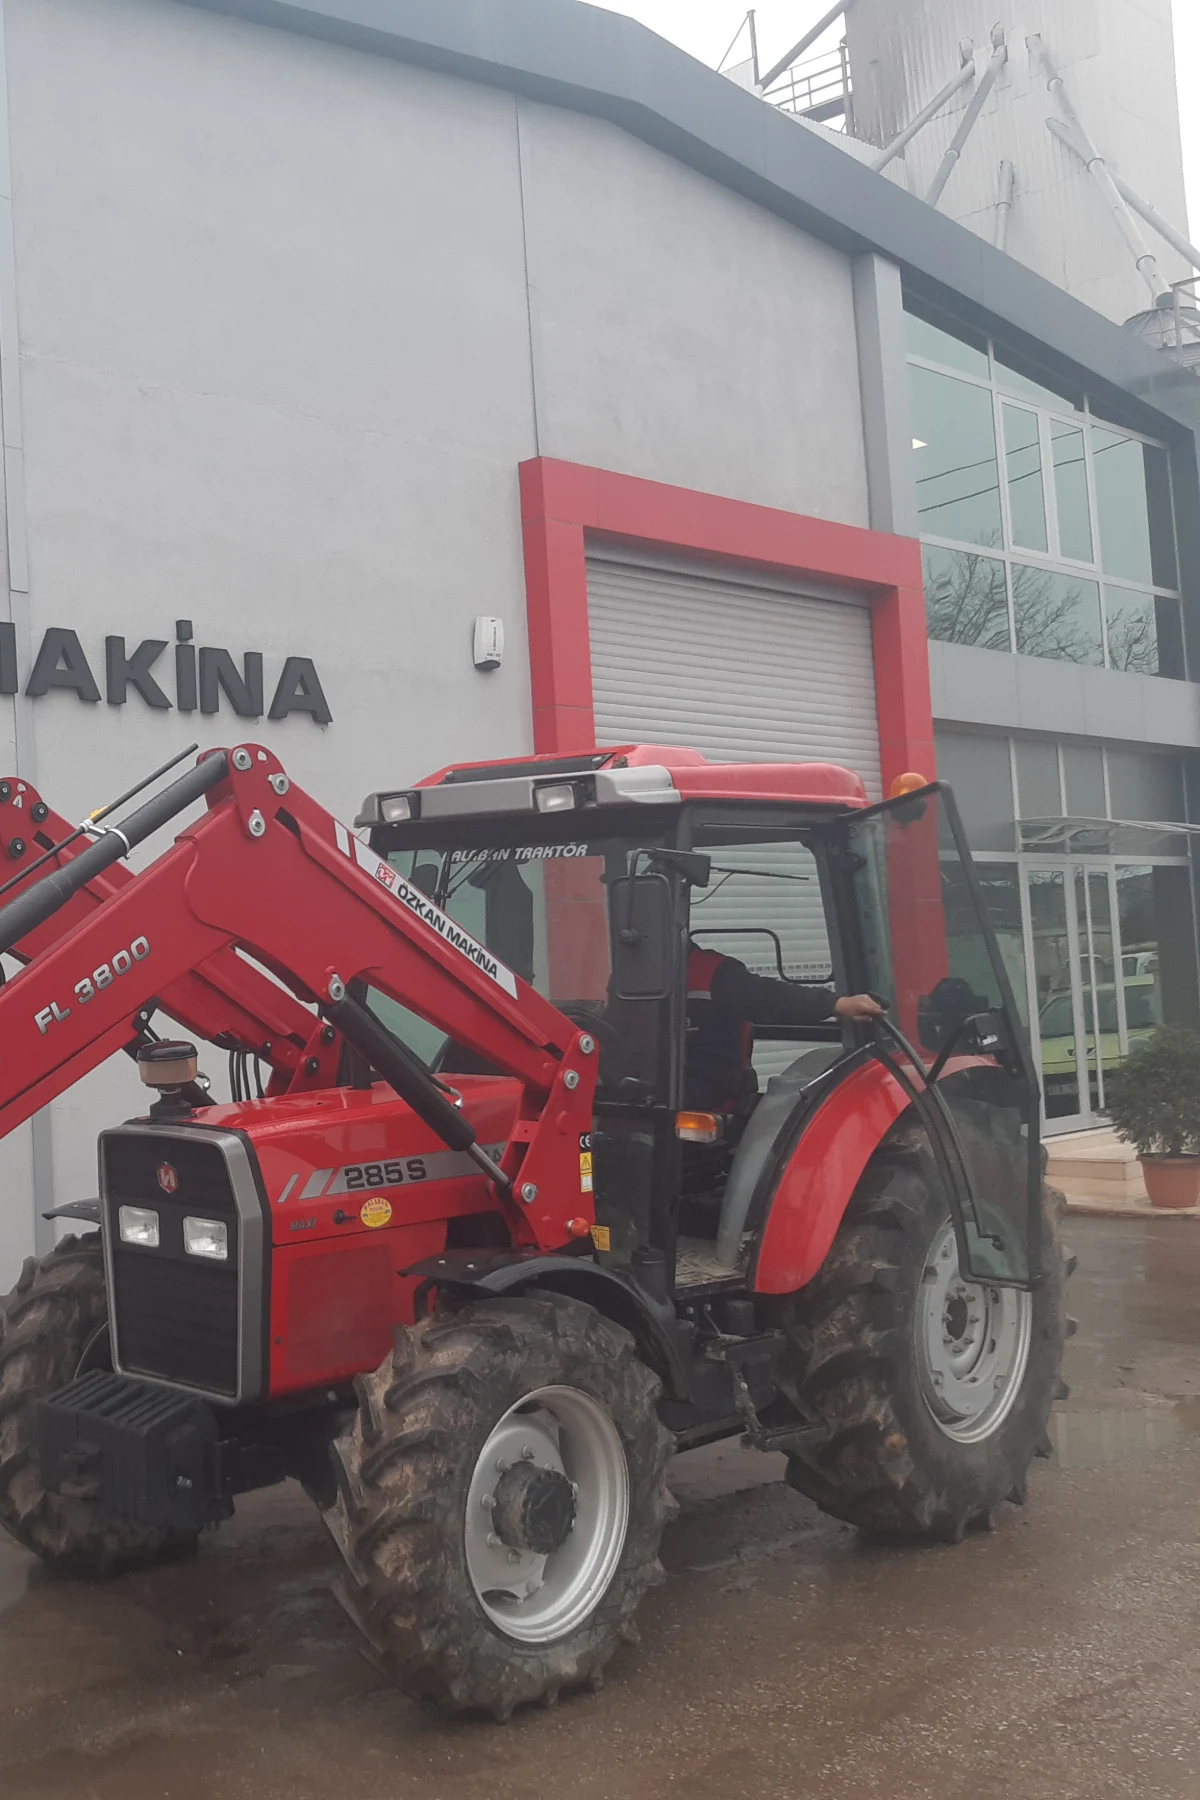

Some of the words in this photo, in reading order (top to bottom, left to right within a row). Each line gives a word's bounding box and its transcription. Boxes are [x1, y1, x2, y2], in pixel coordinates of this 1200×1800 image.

[441, 848, 511, 864] ALABAN
[513, 841, 589, 861] TRAKTÖR
[397, 882, 446, 933] ÖZKAN
[445, 925, 498, 980] MAKİNA
[33, 1000, 71, 1036] FL
[73, 934, 151, 1005] 3800
[343, 1161, 404, 1190] 285
[406, 1158, 428, 1181] S
